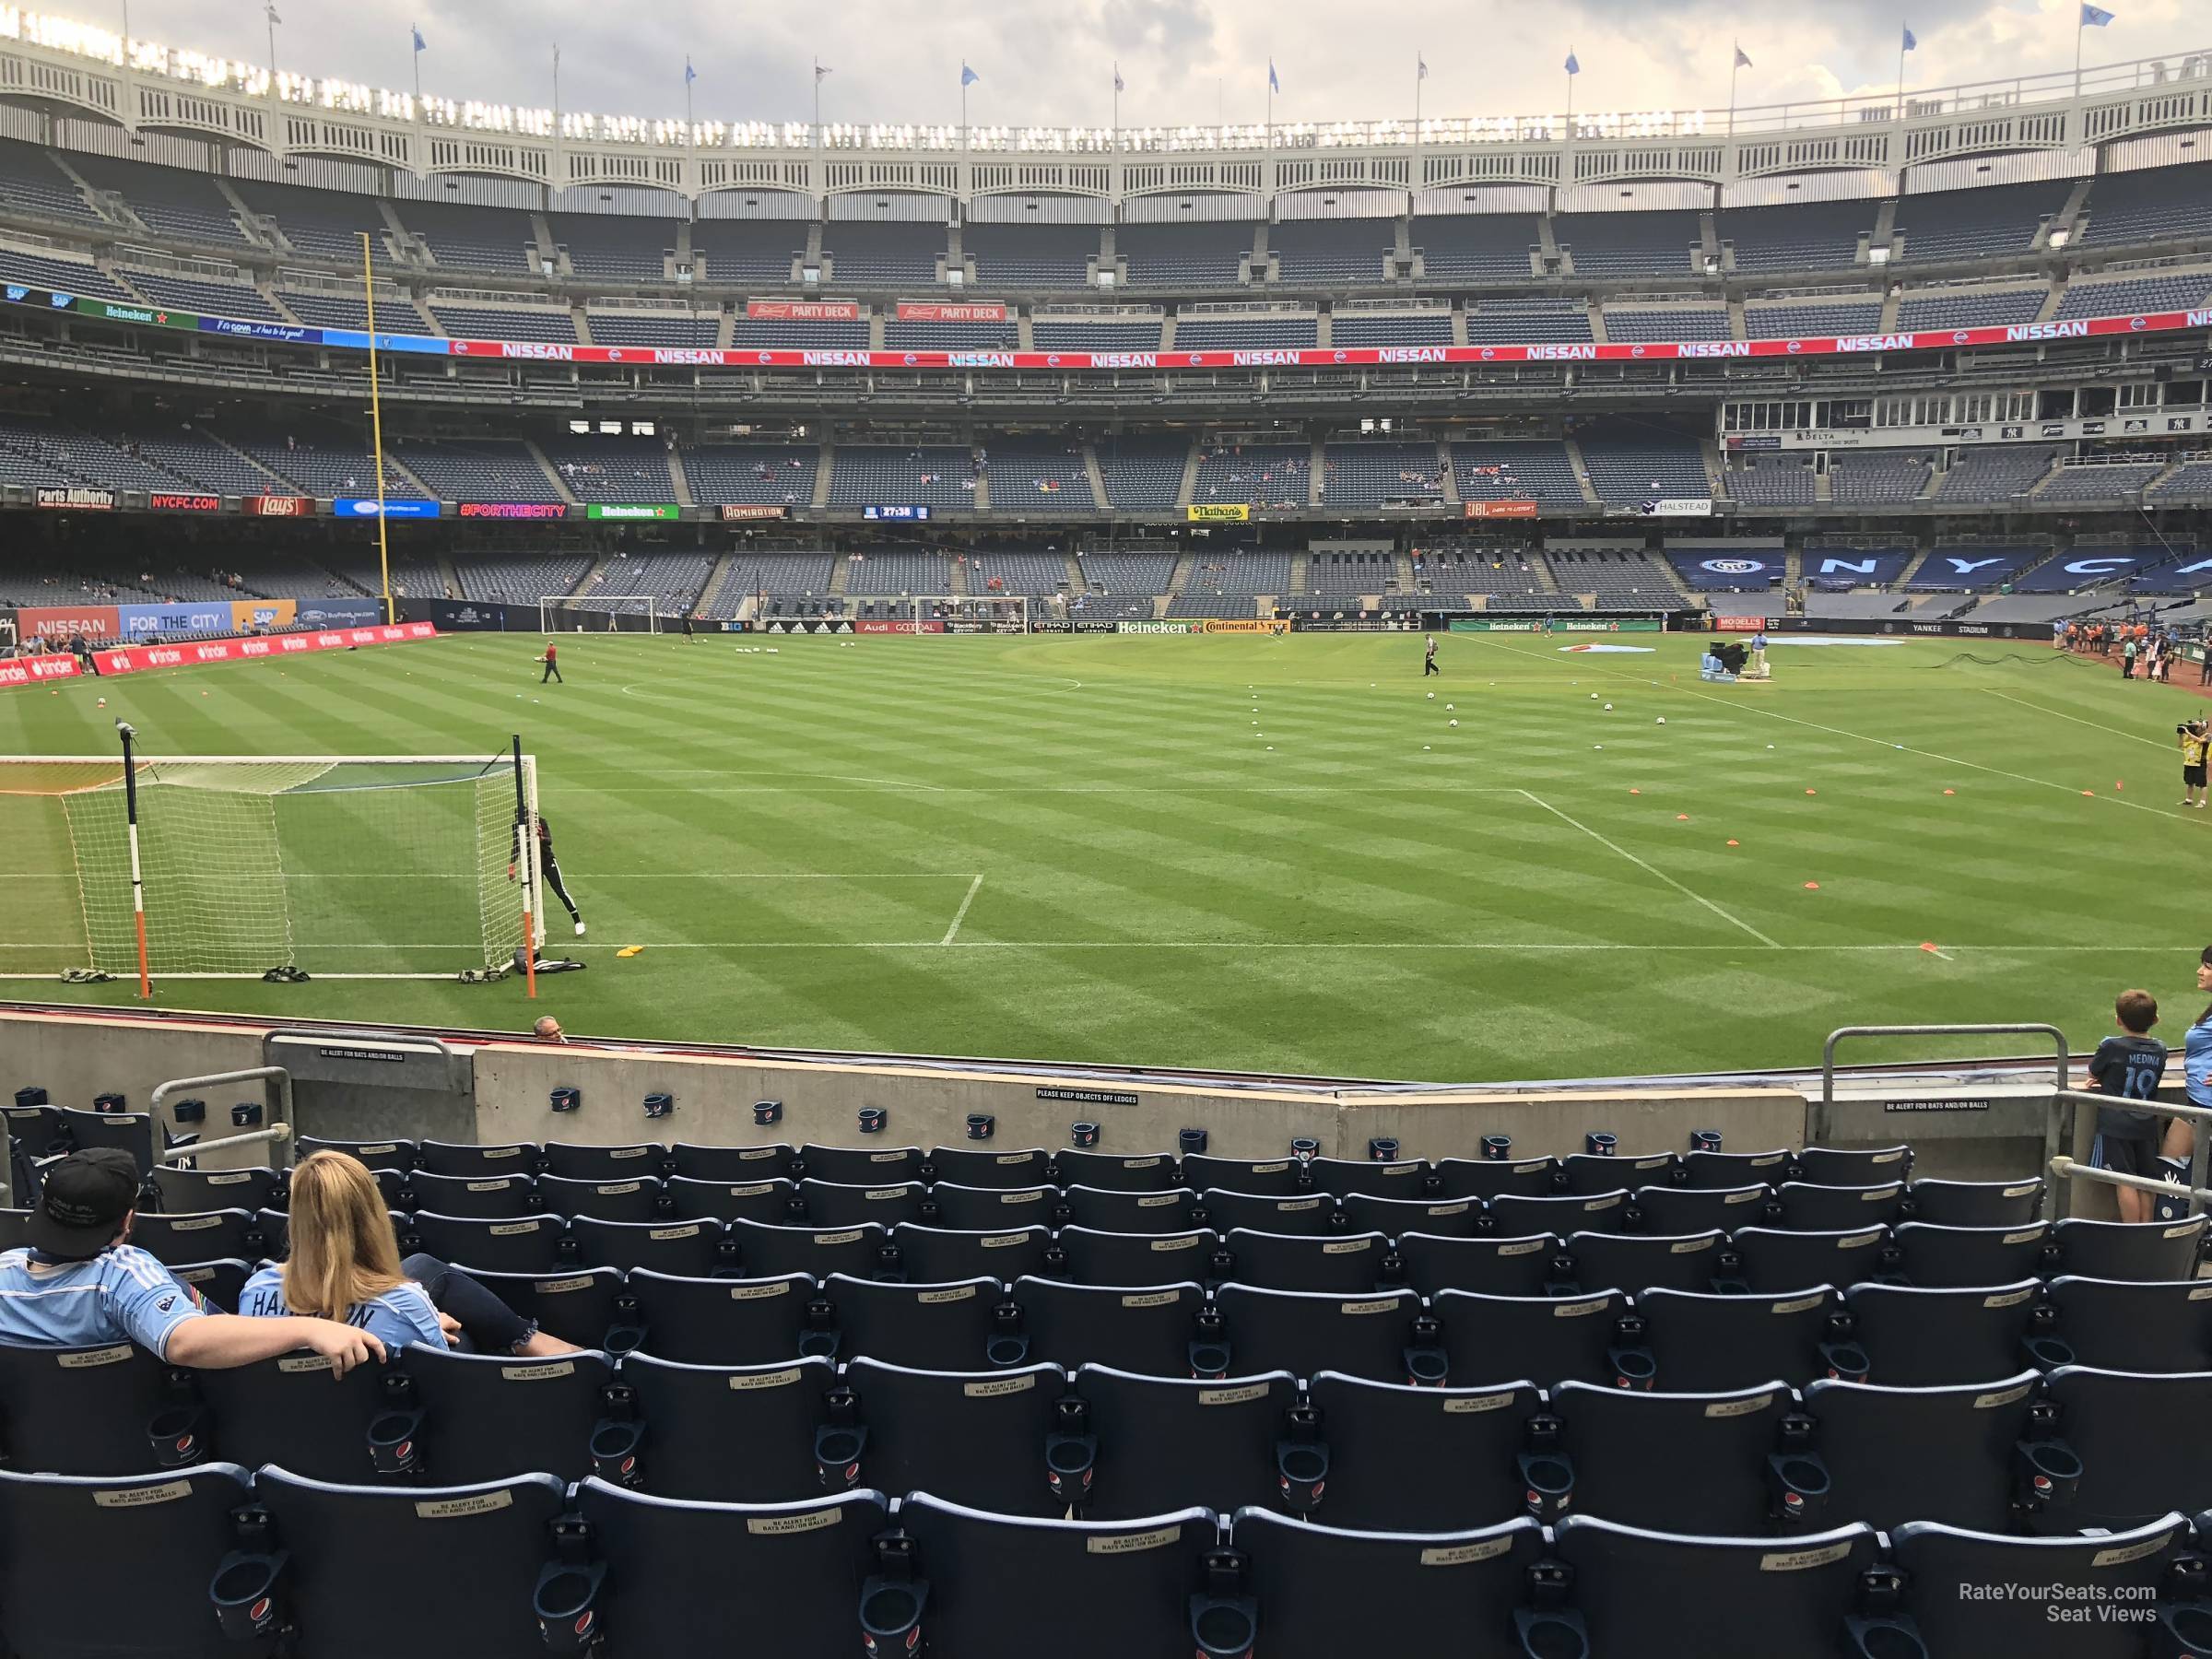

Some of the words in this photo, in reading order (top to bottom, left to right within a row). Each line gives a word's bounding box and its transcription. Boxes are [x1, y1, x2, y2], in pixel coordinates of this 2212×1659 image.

[7, 288, 24, 300] SAP
[52, 296, 69, 308] SAP
[106, 306, 152, 322] Heineken
[792, 306, 822, 317] PARTY
[825, 306, 851, 318] DECK
[940, 307, 971, 318] PARTY
[973, 308, 999, 319] DECK
[2006, 322, 2088, 341] NISSAN
[1836, 335, 1912, 352] NISSAN
[502, 344, 572, 360] NISSAN
[654, 349, 724, 364] NISSAN
[1233, 351, 1299, 365] NISSAN
[1379, 348, 1446, 363] NISSAN
[1526, 346, 1596, 360] NISSAN
[1677, 343, 1750, 359] NISSAN
[803, 352, 870, 366] NISSAN
[948, 354, 1014, 367] NISSAN
[1090, 354, 1156, 368] NISSAN
[38, 489, 65, 503] Parts
[67, 488, 113, 505] Authority
[152, 496, 218, 510] NYCFC.COM
[263, 496, 293, 515] Lay's
[460, 503, 566, 518] #FORTHECITY
[601, 506, 655, 517] Heineken
[726, 506, 782, 518] ADMIRATION
[1194, 506, 1242, 517] Nathan's
[1467, 503, 1489, 516] JBL
[1660, 502, 1708, 511] HALSTEAD
[129, 617, 158, 631] FOR
[161, 616, 187, 629] THE
[191, 614, 219, 629] CITY
[253, 611, 273, 623] SAP
[38, 618, 105, 634] NISSAN
[1118, 621, 1187, 633] Heineken
[1206, 621, 1257, 632] Continental
[1489, 622, 1530, 630] Heineken
[1566, 622, 1607, 630] Heineken
[156, 650, 182, 664] tinder
[206, 645, 228, 658] tinder
[42, 659, 74, 675] tinder
[2129, 1053, 2160, 1066] MEDINA
[2123, 1066, 2157, 1101] 19
[1037, 1089, 1059, 1098] PLEASE
[1060, 1091, 1075, 1100] KEEP
[1076, 1092, 1101, 1101] OBJECTS
[1114, 1095, 1136, 1103] LEDGES
